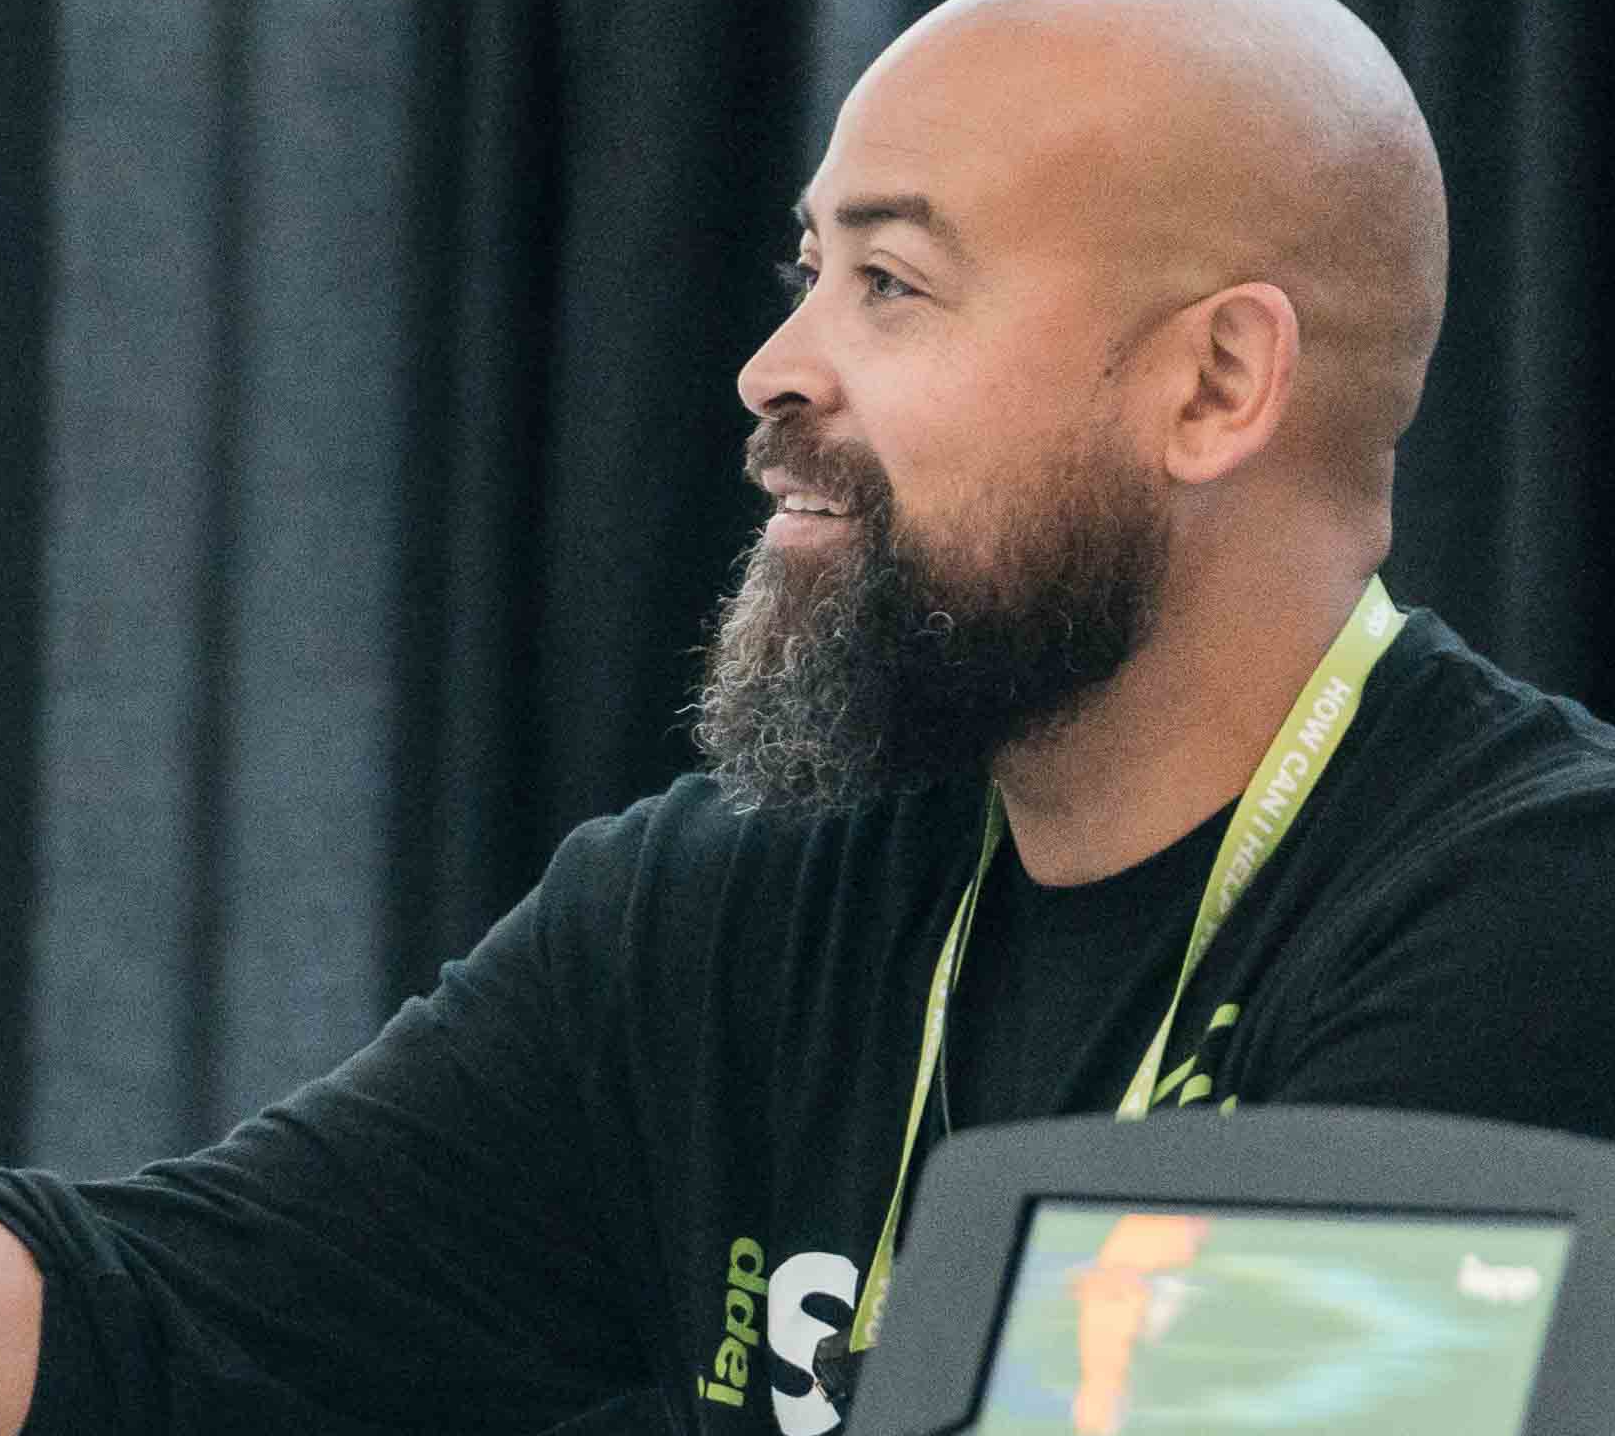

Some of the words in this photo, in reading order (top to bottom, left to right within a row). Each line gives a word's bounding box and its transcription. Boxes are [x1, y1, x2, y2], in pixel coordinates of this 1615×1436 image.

[1297, 675, 1353, 755] HOW
[1259, 750, 1310, 819] CAN
[696, 1236, 769, 1408] iapp
